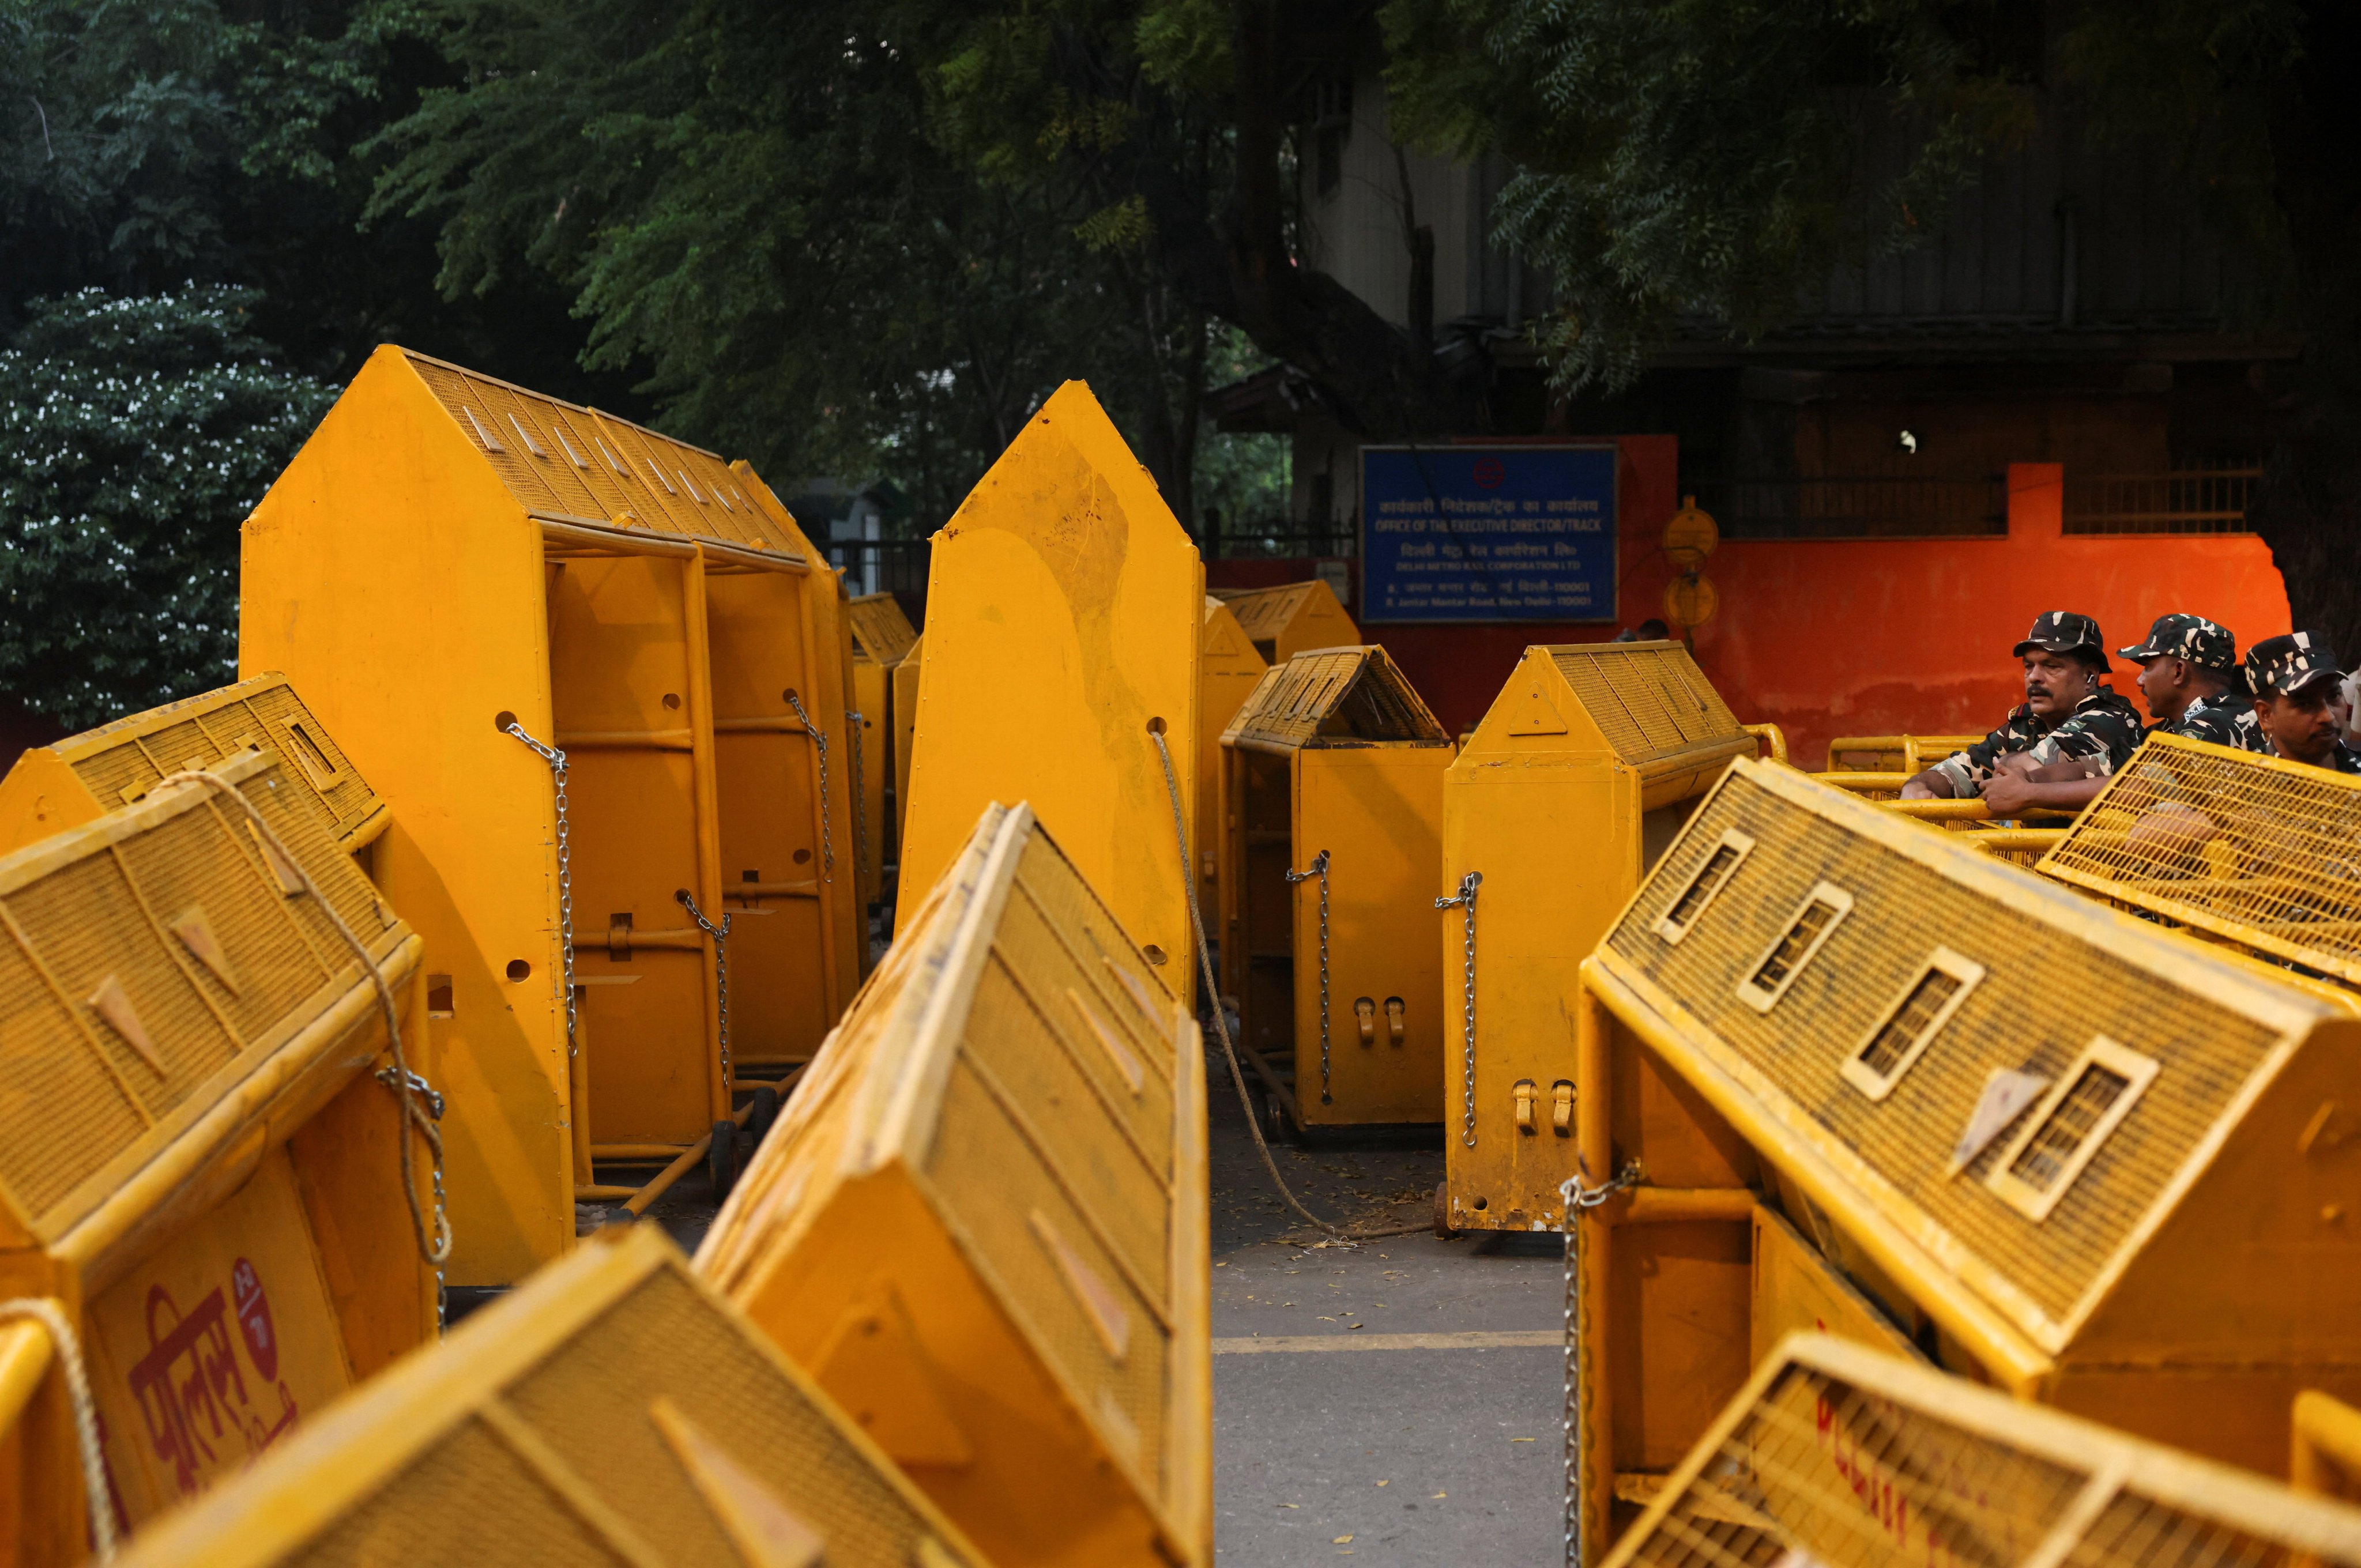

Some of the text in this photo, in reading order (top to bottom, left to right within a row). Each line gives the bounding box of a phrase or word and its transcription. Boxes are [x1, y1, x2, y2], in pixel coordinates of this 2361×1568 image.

[1523, 500, 1539, 513] का
[1546, 496, 1599, 513] कार्यालय
[1375, 519, 1601, 533] OFFICE OF THE EXECUTIVE DIRECTOR/TRACK
[1400, 541, 1435, 557] दिल्ली
[1469, 542, 1488, 557] रेल
[1396, 561, 1425, 571] DELHI
[1426, 561, 1461, 571] METRO
[1463, 561, 1484, 571] RAIL
[1487, 561, 1559, 571] CORPORATION
[1399, 598, 1428, 607] Jantar
[1430, 597, 1466, 607] Mantar
[2186, 703, 2206, 720] S.S.B.
